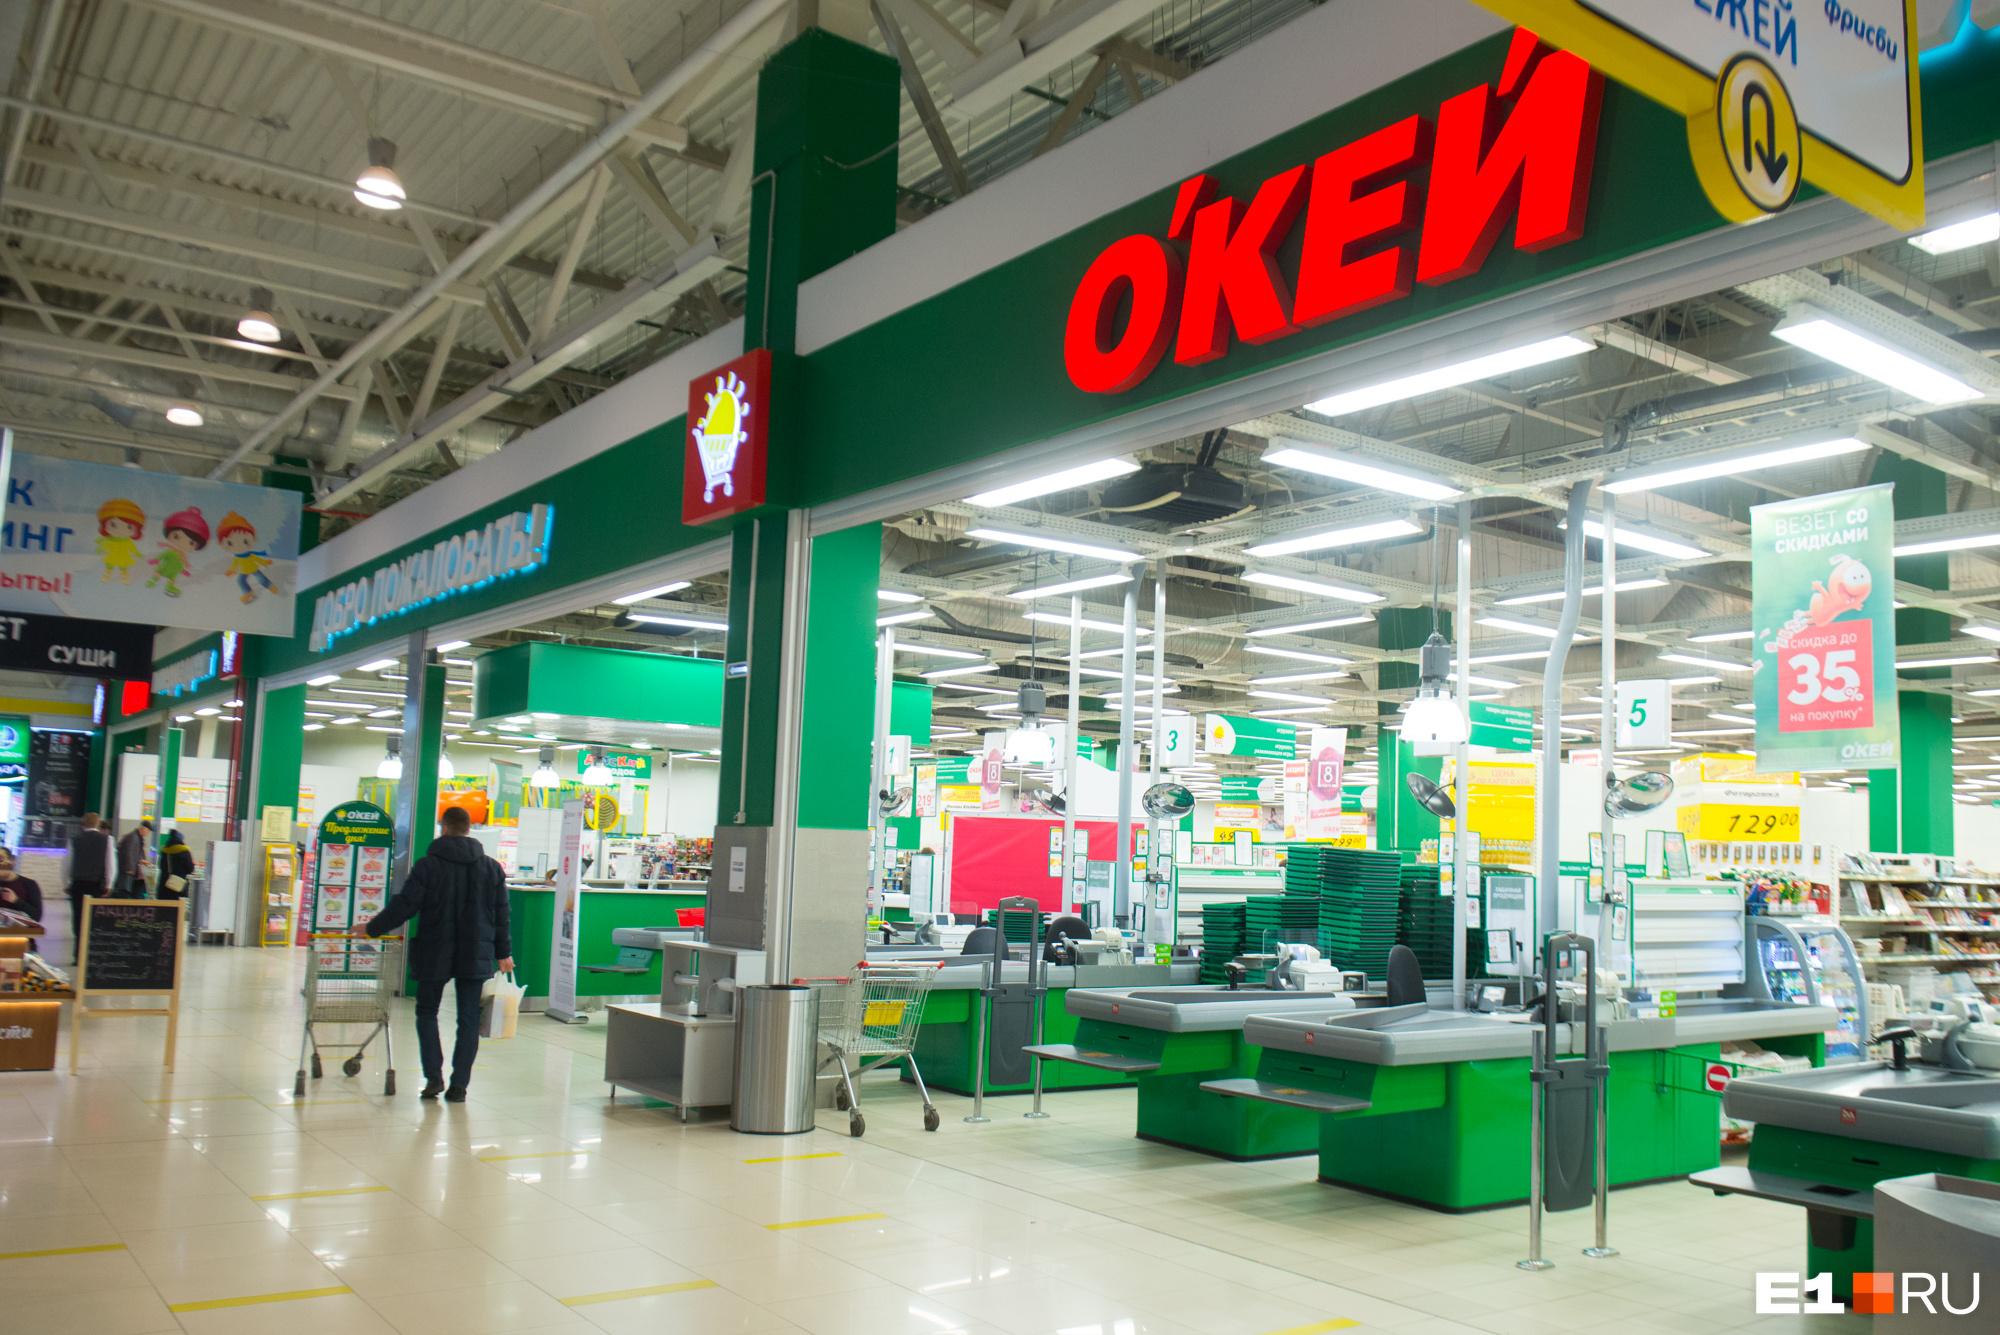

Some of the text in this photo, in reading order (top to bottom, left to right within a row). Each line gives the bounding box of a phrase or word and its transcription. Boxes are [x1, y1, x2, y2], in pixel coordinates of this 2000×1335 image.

[1694, 0, 1798, 66] ЖЕЙ
[1064, 25, 1603, 395] О'КЕЙ
[1846, 507, 1868, 525] СО
[1775, 527, 1868, 553] СКИДКАМИ
[309, 576, 370, 653] ДОБРО
[369, 503, 554, 616] ПОЖАЛОВАТЬ!
[1790, 633, 1857, 649] скидка до
[1629, 699, 1647, 726] 5
[1790, 713, 1805, 722] на
[1167, 730, 1178, 751] 3
[889, 746, 895, 763] 1
[1323, 767, 1333, 783] 8
